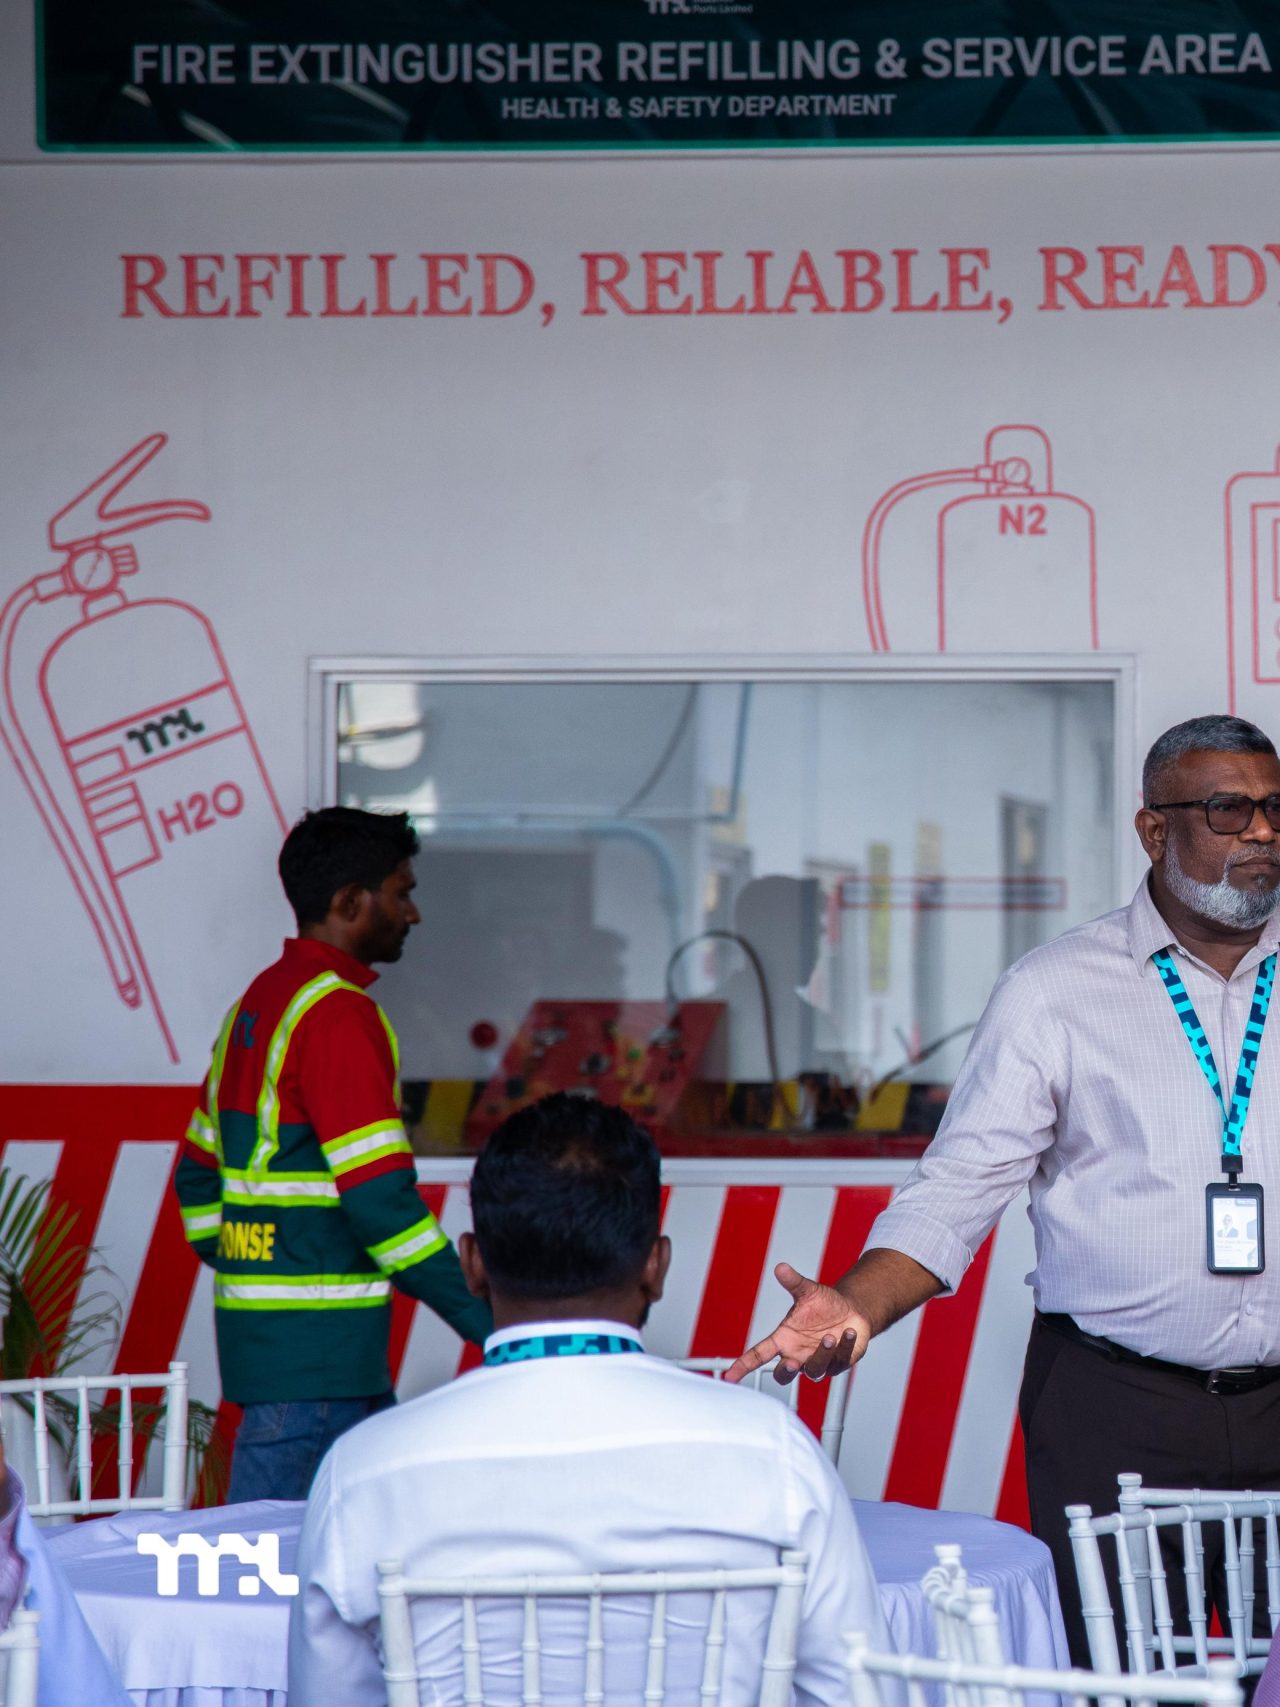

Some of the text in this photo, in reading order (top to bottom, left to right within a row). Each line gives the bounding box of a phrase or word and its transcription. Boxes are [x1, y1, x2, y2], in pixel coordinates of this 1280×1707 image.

[134, 34, 1271, 83] FIRE EXTINGUISHER REFILLING & SERVICE AREA
[503, 95, 896, 119] HEALTH & SAFETY DEPARTMENT
[120, 252, 555, 327] REFILLED,
[579, 247, 1013, 324] RELIABLE,
[998, 503, 1047, 536] N2
[157, 781, 244, 842] H2O
